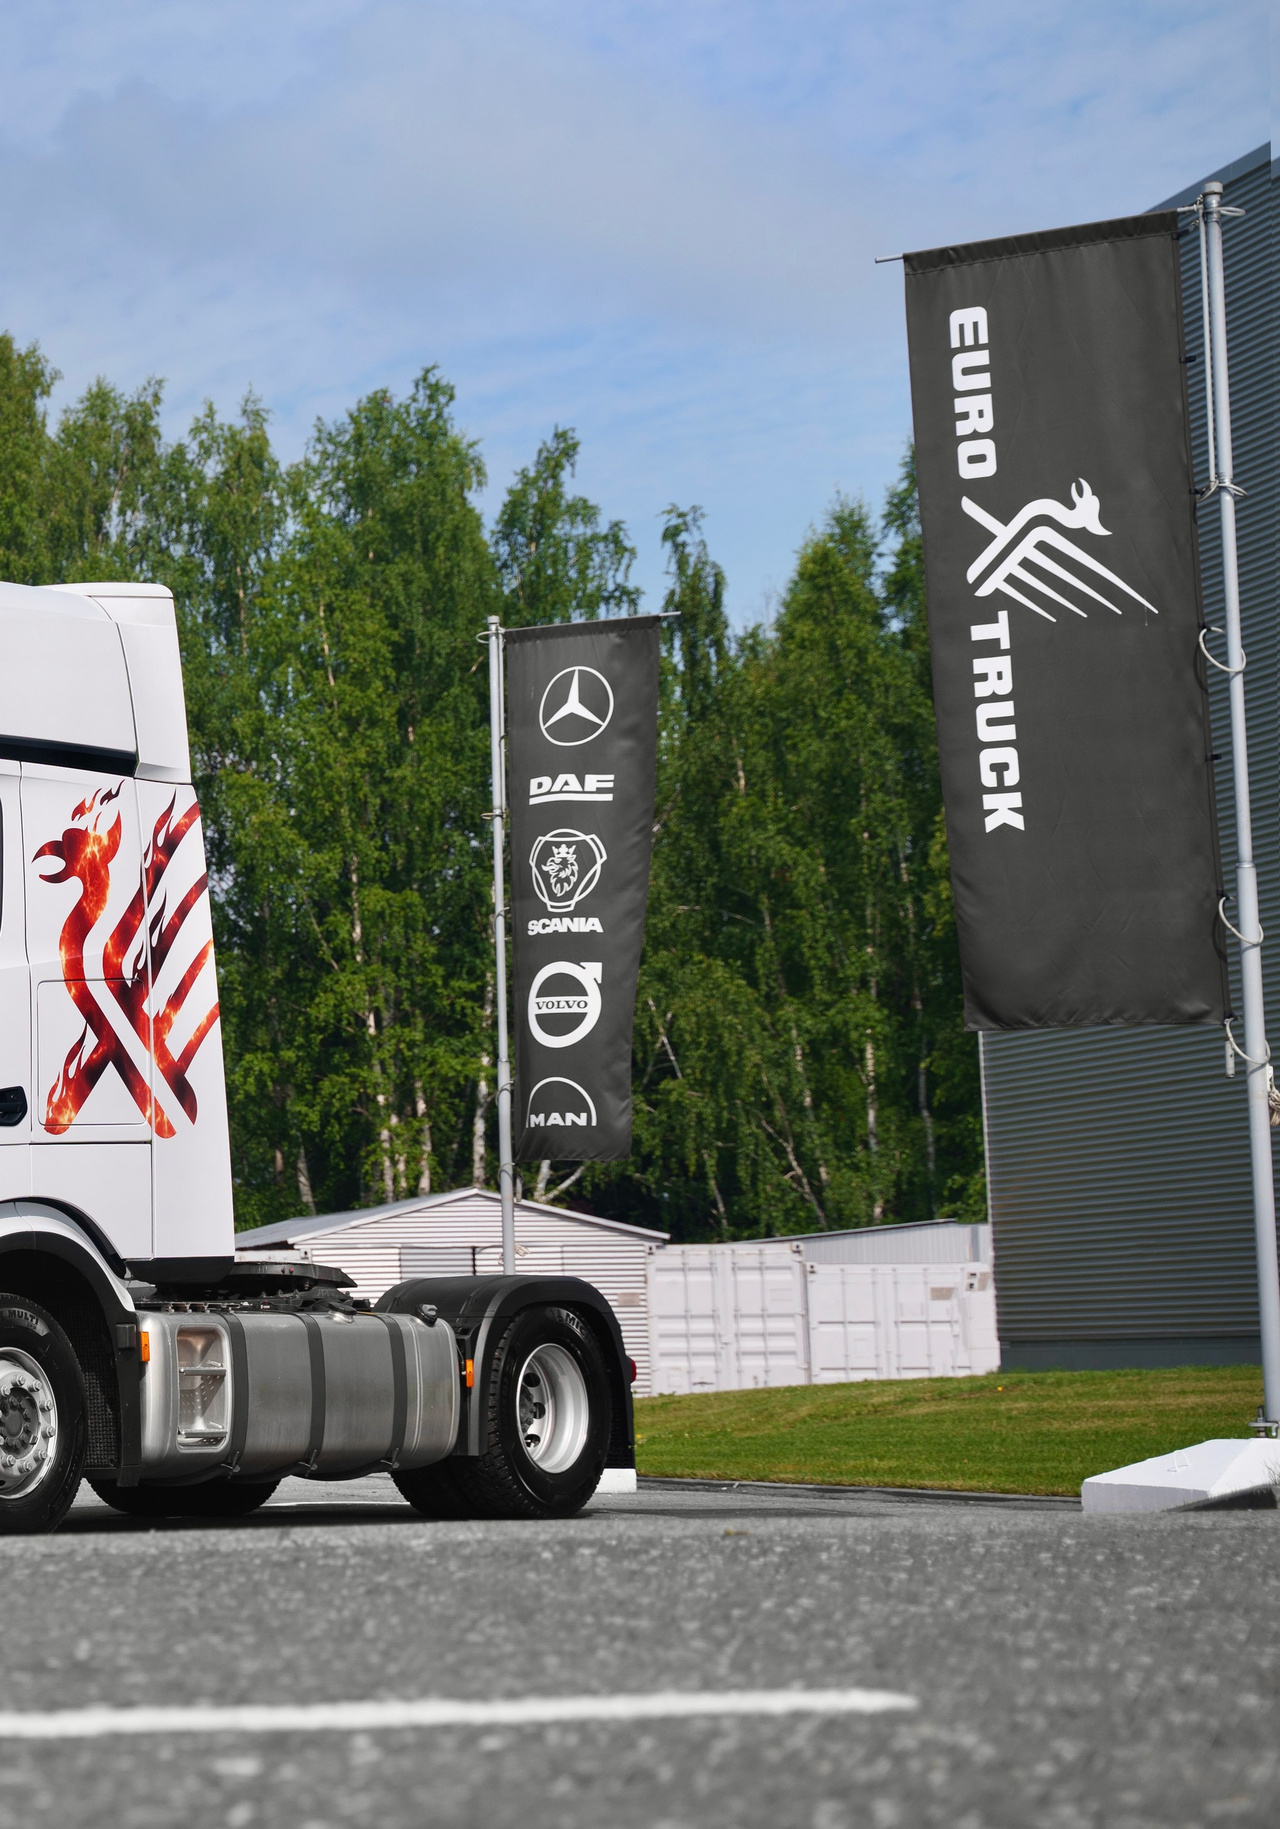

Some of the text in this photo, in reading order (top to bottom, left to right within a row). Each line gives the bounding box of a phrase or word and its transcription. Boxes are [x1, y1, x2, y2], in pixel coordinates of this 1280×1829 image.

[949, 305, 1026, 834] EURO TRUCK
[529, 773, 615, 796] DAF
[527, 916, 604, 936] SCANIA
[535, 1000, 588, 1010] VOLVO
[530, 1112, 588, 1127] MAN
[8, 1309, 39, 1325] MULTI
